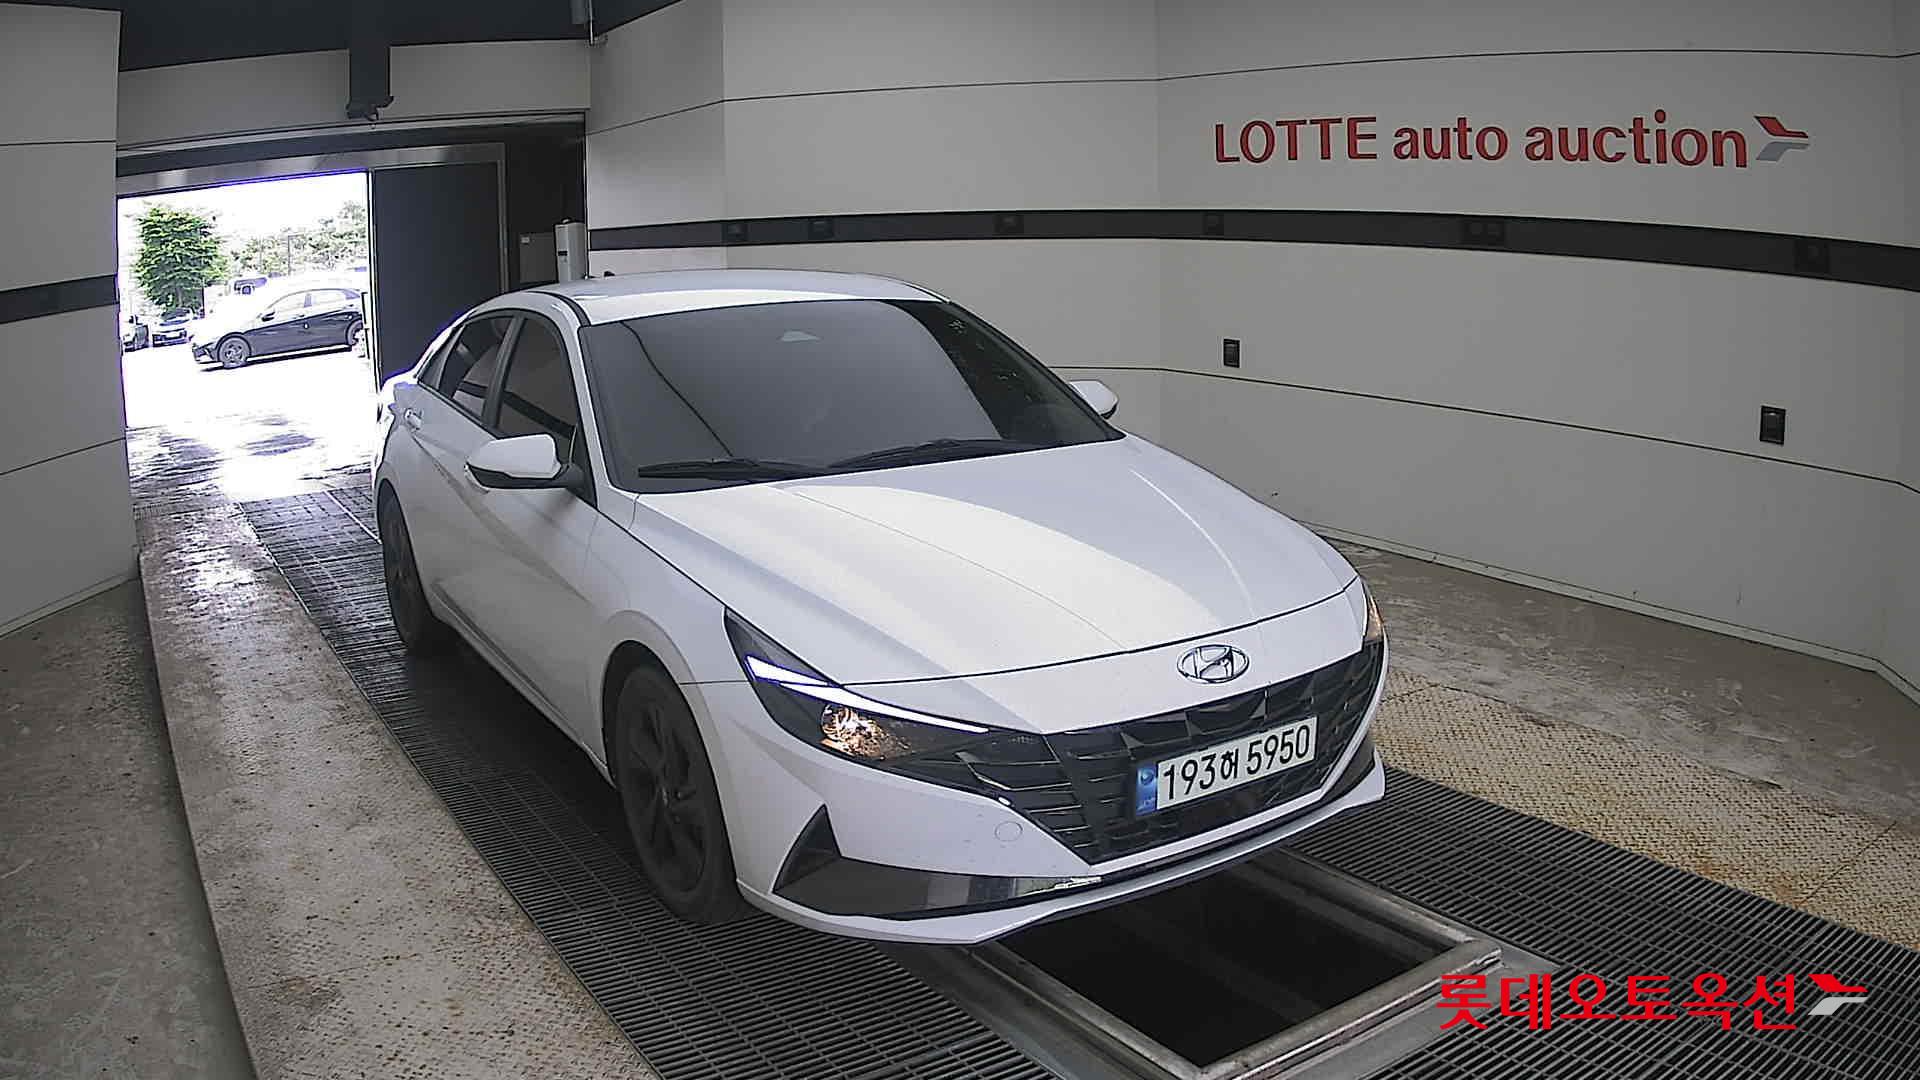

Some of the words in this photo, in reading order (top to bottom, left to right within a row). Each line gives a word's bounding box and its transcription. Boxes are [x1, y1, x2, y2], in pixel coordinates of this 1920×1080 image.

[1215, 116, 1377, 163] LOTTE
[1393, 117, 1508, 161] auto
[1525, 109, 1748, 168] auction
[1163, 748, 1239, 800] 193허
[1246, 724, 1310, 775] 5950
